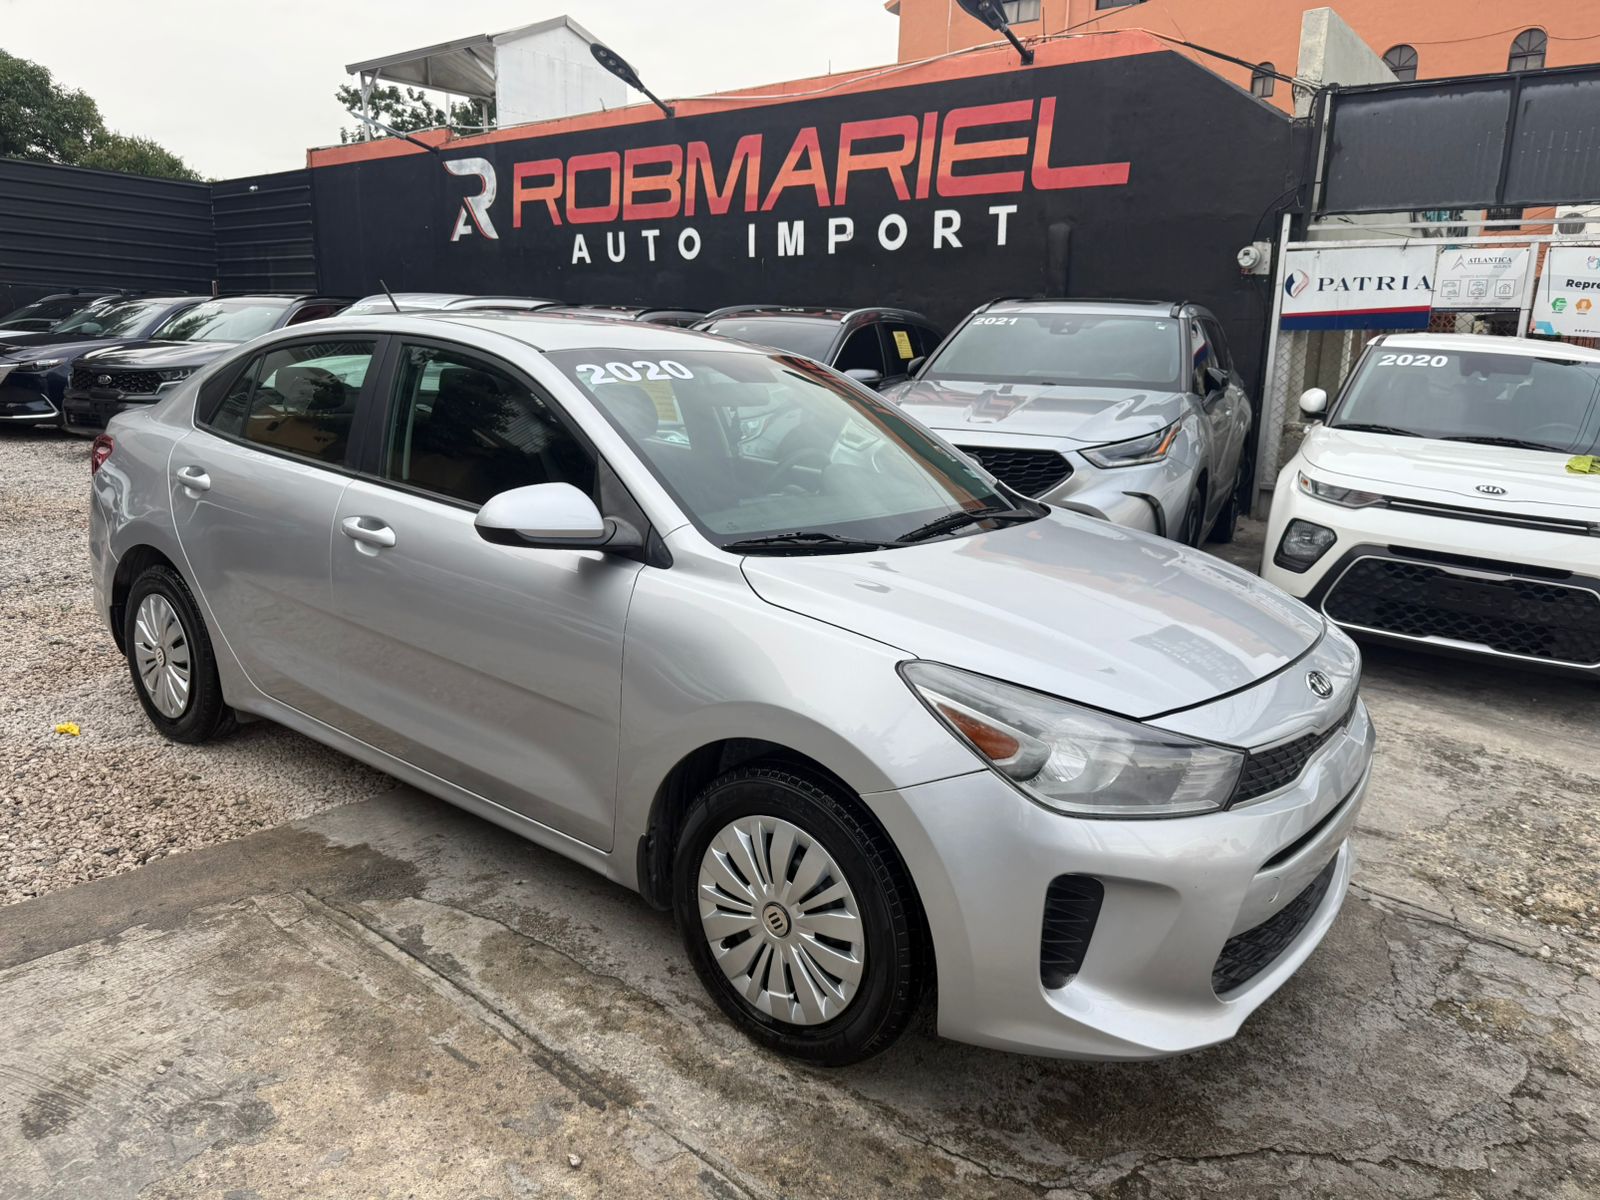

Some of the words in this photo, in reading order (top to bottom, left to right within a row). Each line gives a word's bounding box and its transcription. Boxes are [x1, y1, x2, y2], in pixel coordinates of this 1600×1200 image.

[512, 96, 1131, 228] ROBMARIEL
[571, 227, 701, 264] AUTO
[747, 205, 1018, 258] IMPORT
[1467, 256, 1513, 264] ATLANTICA
[1315, 274, 1432, 292] PATRIA
[972, 317, 1018, 325] 2021
[1377, 354, 1449, 368] 2020
[575, 360, 694, 385] 2020
[1479, 484, 1504, 495] KIA
